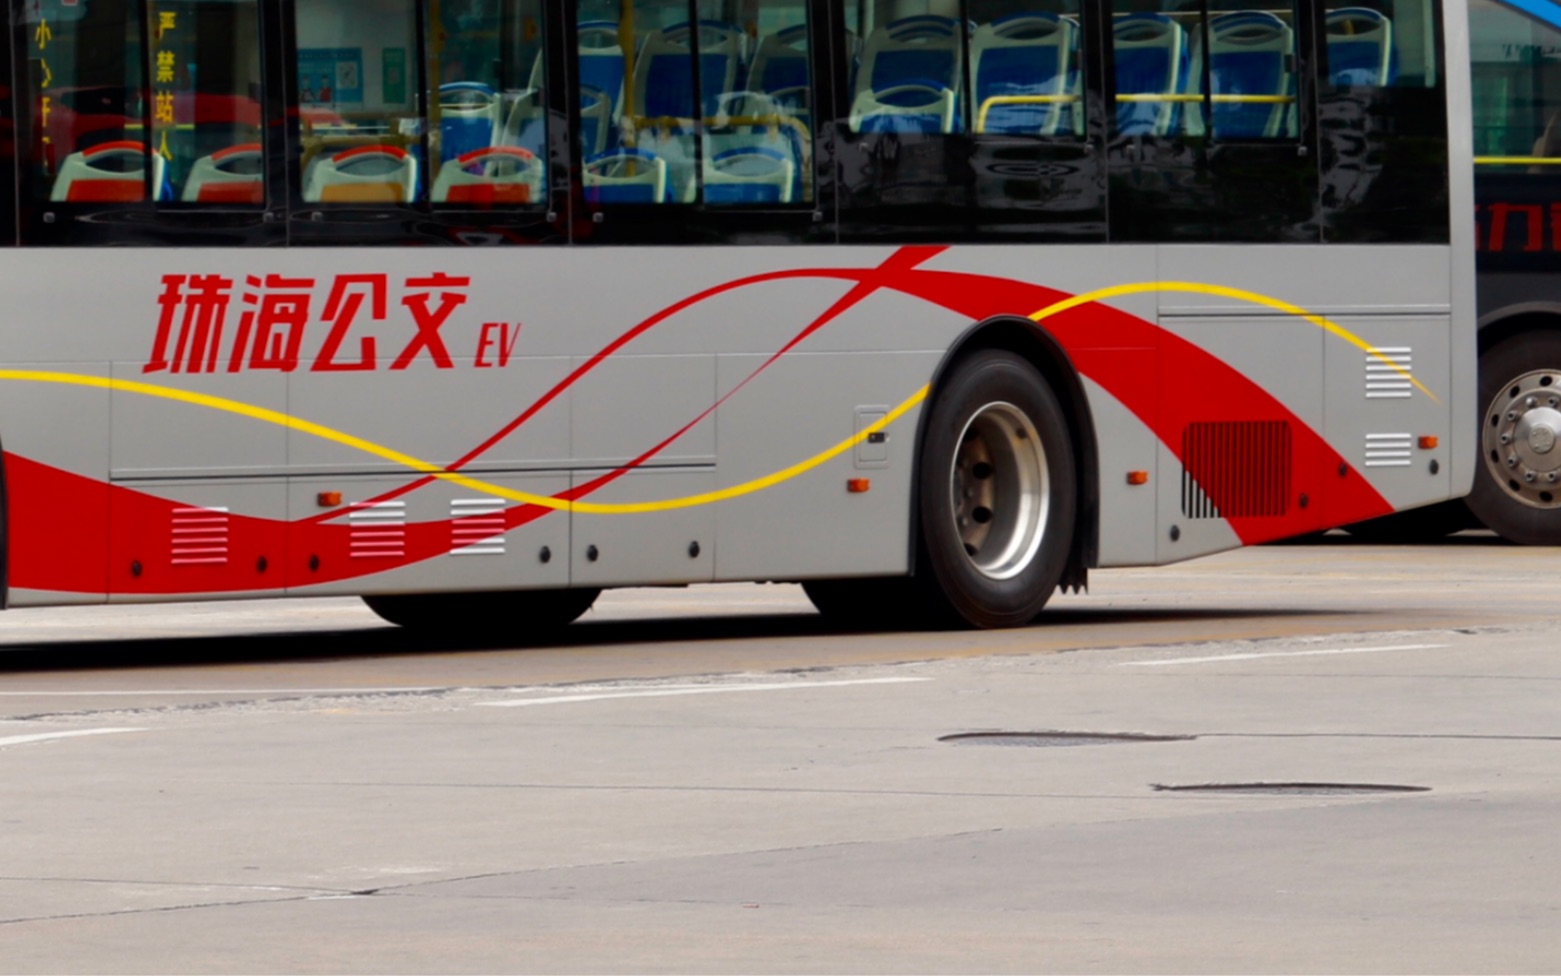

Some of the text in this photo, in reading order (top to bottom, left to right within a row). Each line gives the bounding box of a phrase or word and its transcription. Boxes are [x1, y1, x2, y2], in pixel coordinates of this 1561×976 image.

[156, 12, 177, 160] 严禁站人
[142, 272, 522, 373] 珠海公交 EV
